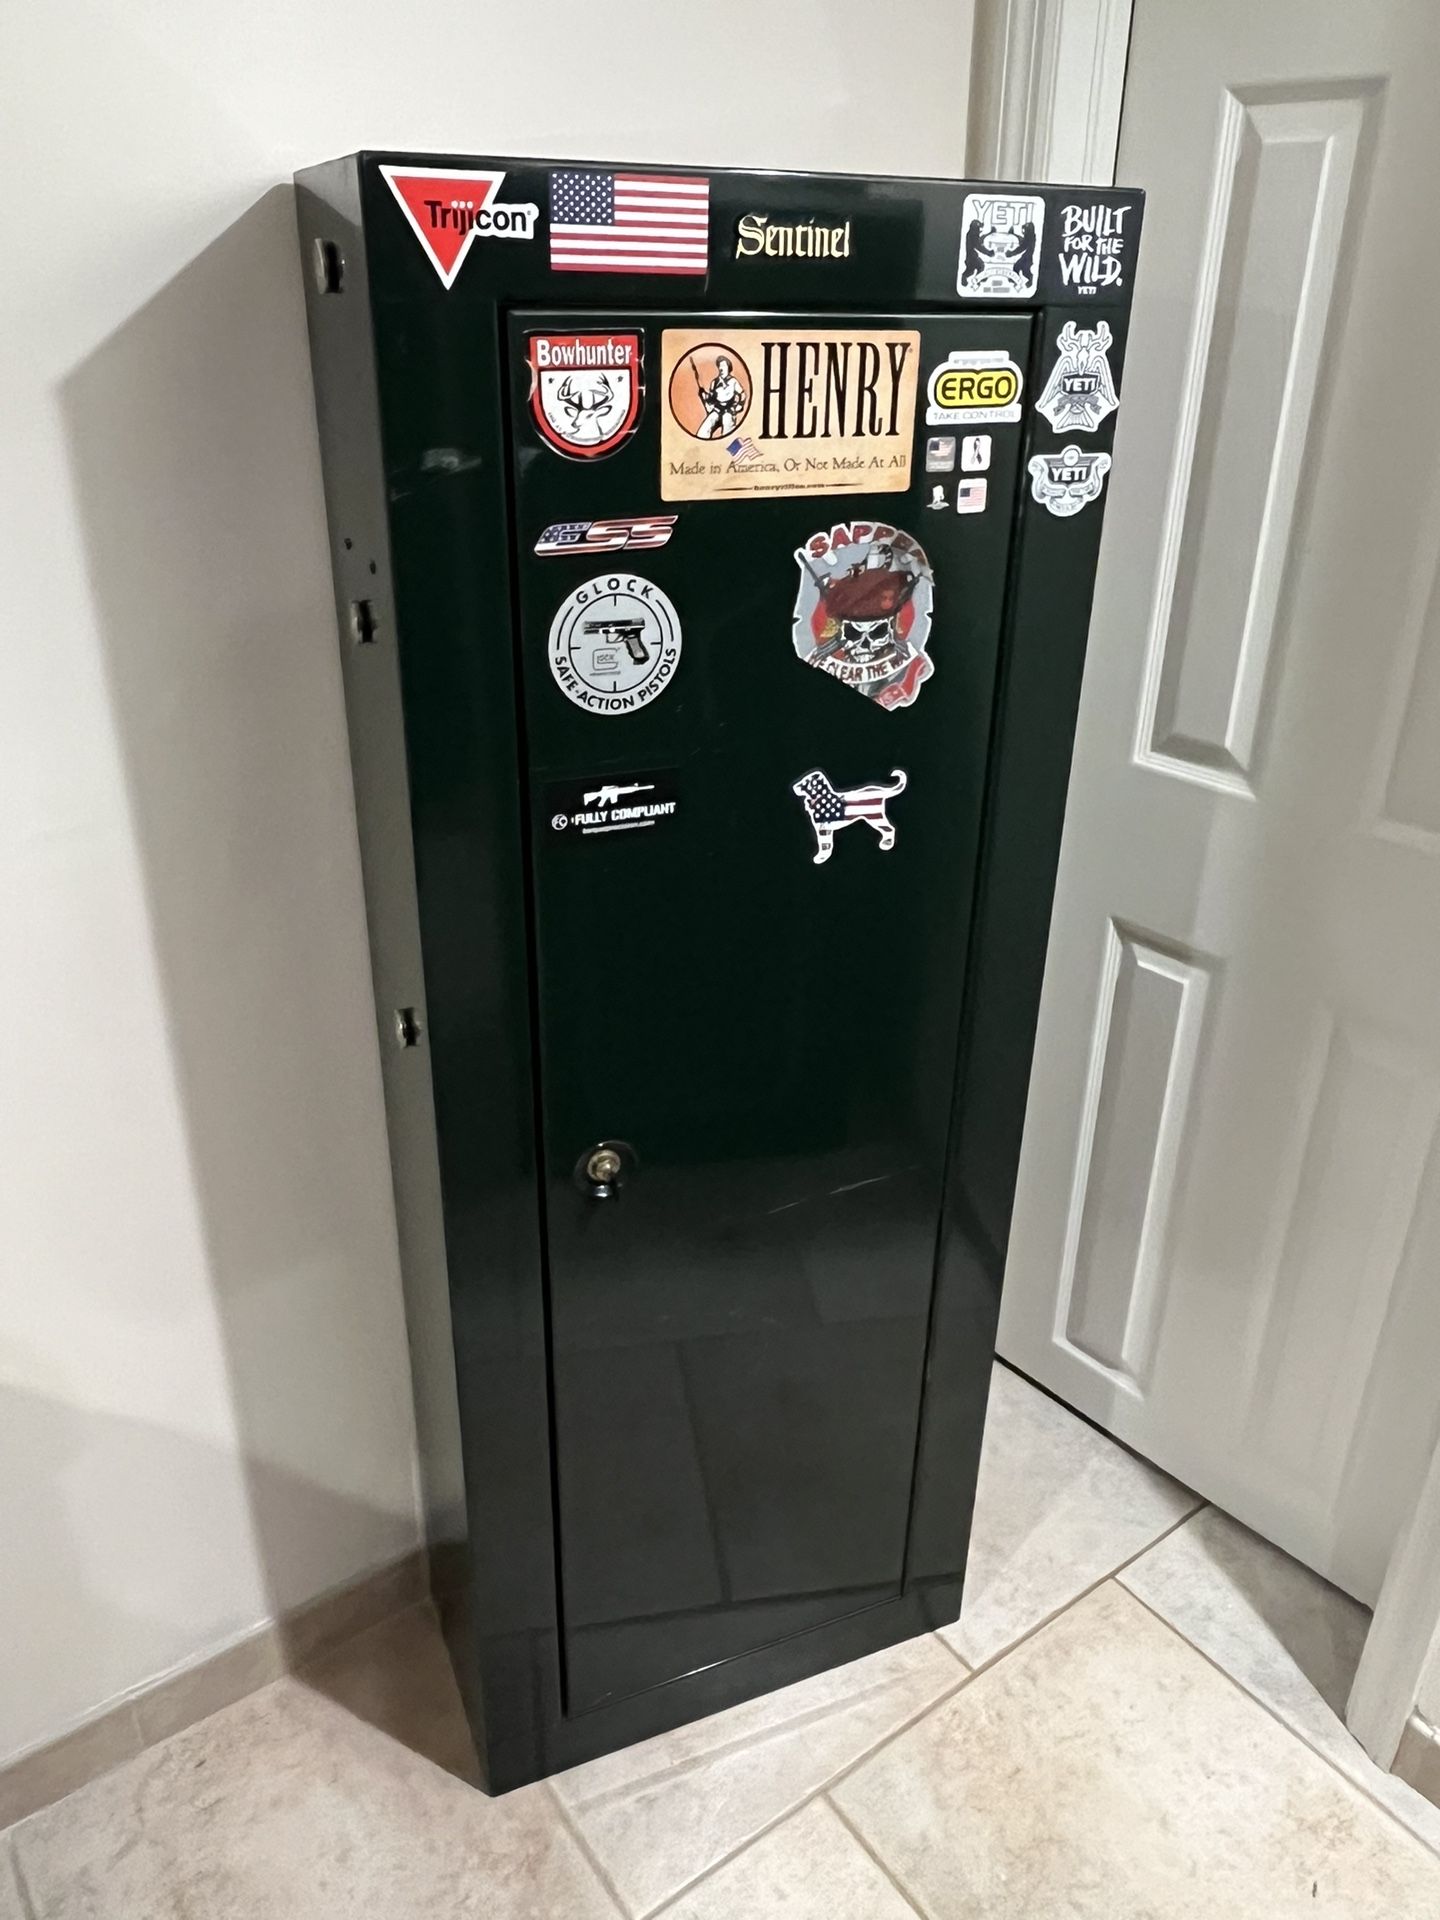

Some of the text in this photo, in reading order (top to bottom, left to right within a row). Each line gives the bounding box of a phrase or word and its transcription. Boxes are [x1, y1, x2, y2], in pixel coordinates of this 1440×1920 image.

[424, 200, 527, 235] Trijicon
[972, 199, 1036, 226] YETI
[1060, 205, 1132, 237] BUILT
[736, 213, 850, 259] Sentinel
[1063, 234, 1124, 255] FOR THE
[1058, 252, 1123, 287] WILD.
[1078, 286, 1097, 295] YETI
[537, 338, 632, 367] Bowhunter
[758, 341, 911, 441] HENRY
[941, 376, 1012, 400] ERGO
[1063, 376, 1097, 392] YETI
[933, 409, 1015, 421] TAKE CONTROL
[670, 455, 906, 475] Made in America, Or Not Made At All
[1051, 467, 1087, 481] YETI
[534, 515, 678, 556] ESS
[576, 578, 654, 605] GLOCK
[555, 648, 677, 710] SAFE-ACTION PISTOLS
[865, 662, 888, 679] THE
[575, 810, 608, 826] FULLY
[611, 801, 676, 822] COMPLIANT
